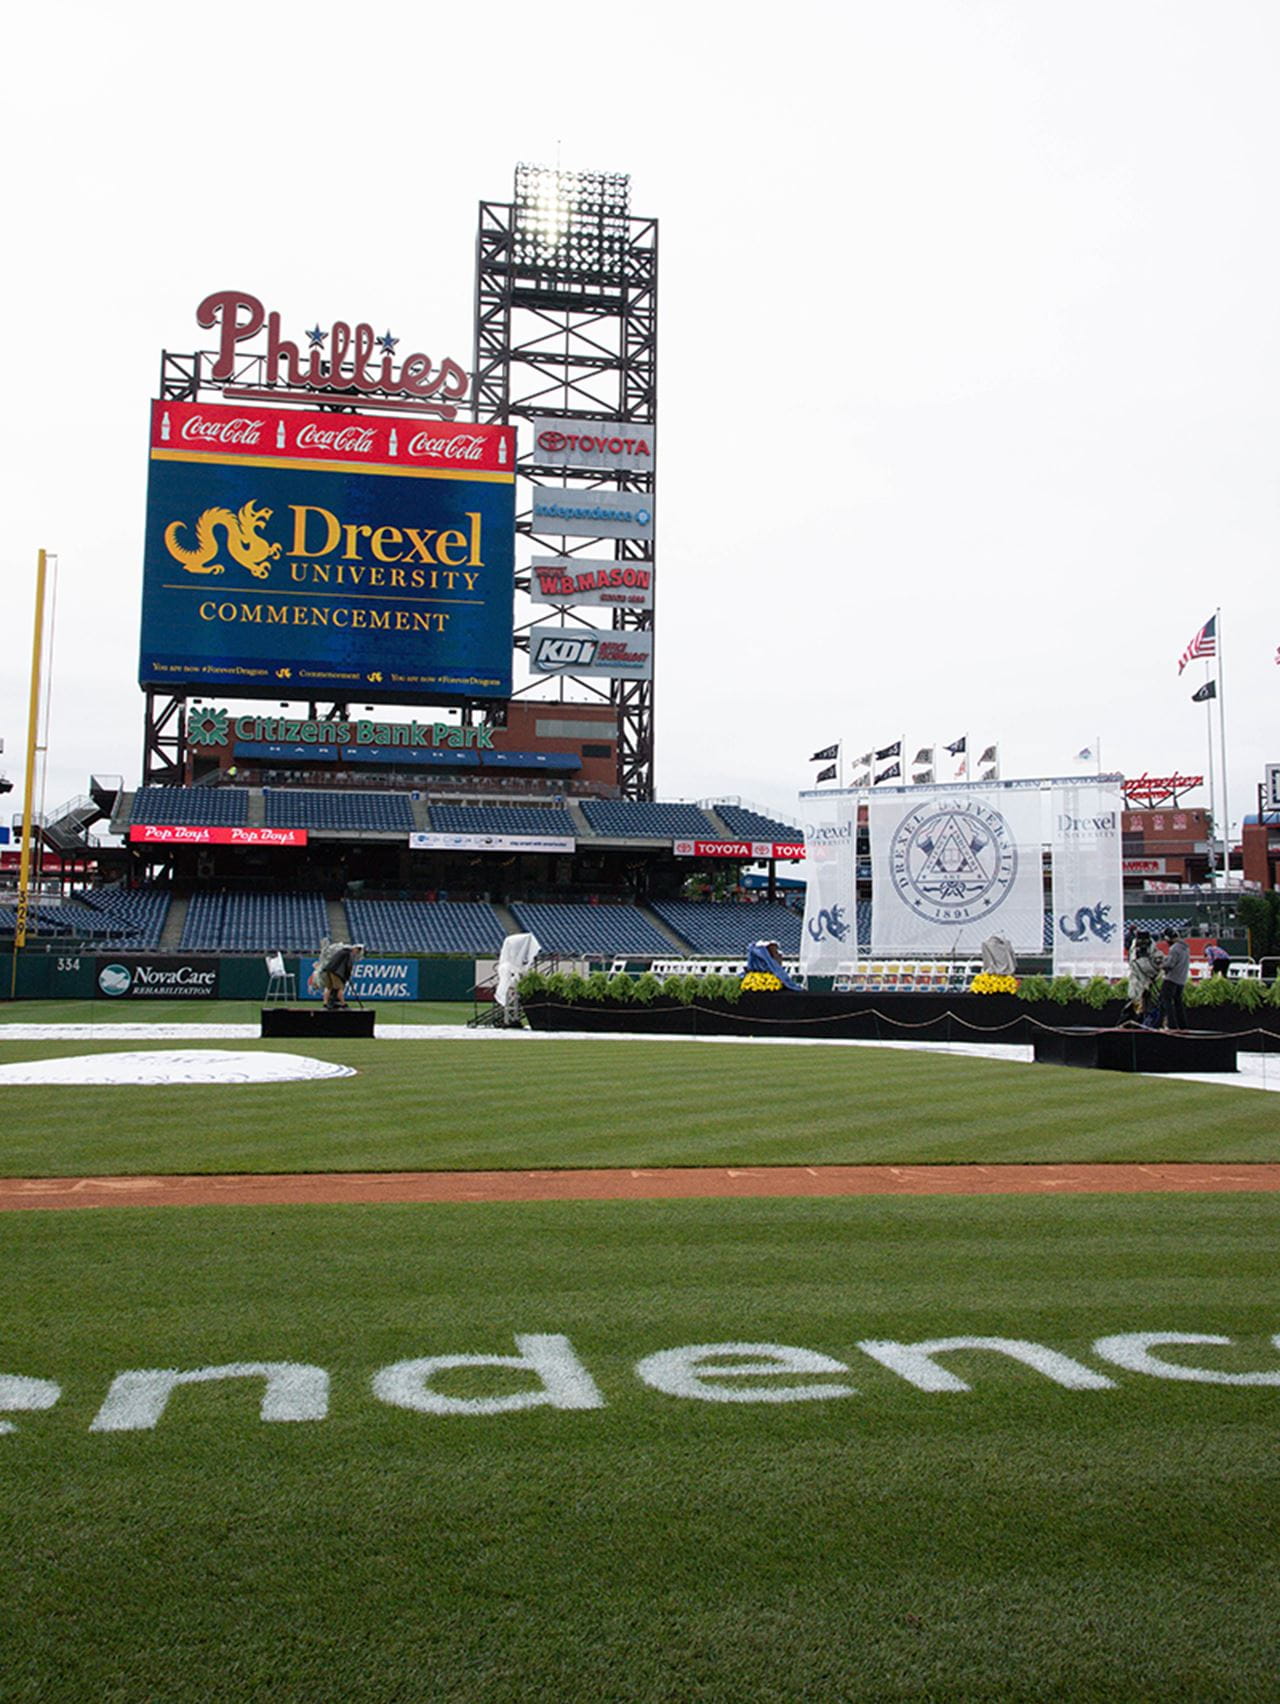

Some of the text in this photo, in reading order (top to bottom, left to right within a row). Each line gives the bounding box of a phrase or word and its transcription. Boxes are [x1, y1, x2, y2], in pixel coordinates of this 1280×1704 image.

[196, 290, 469, 400] Phillies
[181, 415, 266, 445] Coca-Cola
[296, 423, 378, 453] Coca-Cola
[408, 431, 488, 460] Coca-Cola
[567, 434, 651, 457] TOYOTA
[286, 504, 485, 567] Drexel
[290, 562, 480, 591] UNIVERSITY
[199, 601, 449, 632] COMMENCEMENT
[537, 640, 597, 664] KDI
[235, 715, 495, 749] Citizens Bank Park
[805, 821, 852, 839] Drexel
[1058, 812, 1116, 832] Drexel
[175, 827, 210, 842] Boys
[261, 829, 295, 844] Boys
[698, 843, 749, 855] TOYOTA
[935, 908, 970, 919] 1891
[57, 957, 81, 971] 334
[133, 966, 215, 985] NovaCare
[132, 986, 212, 996] REHABILITATION
